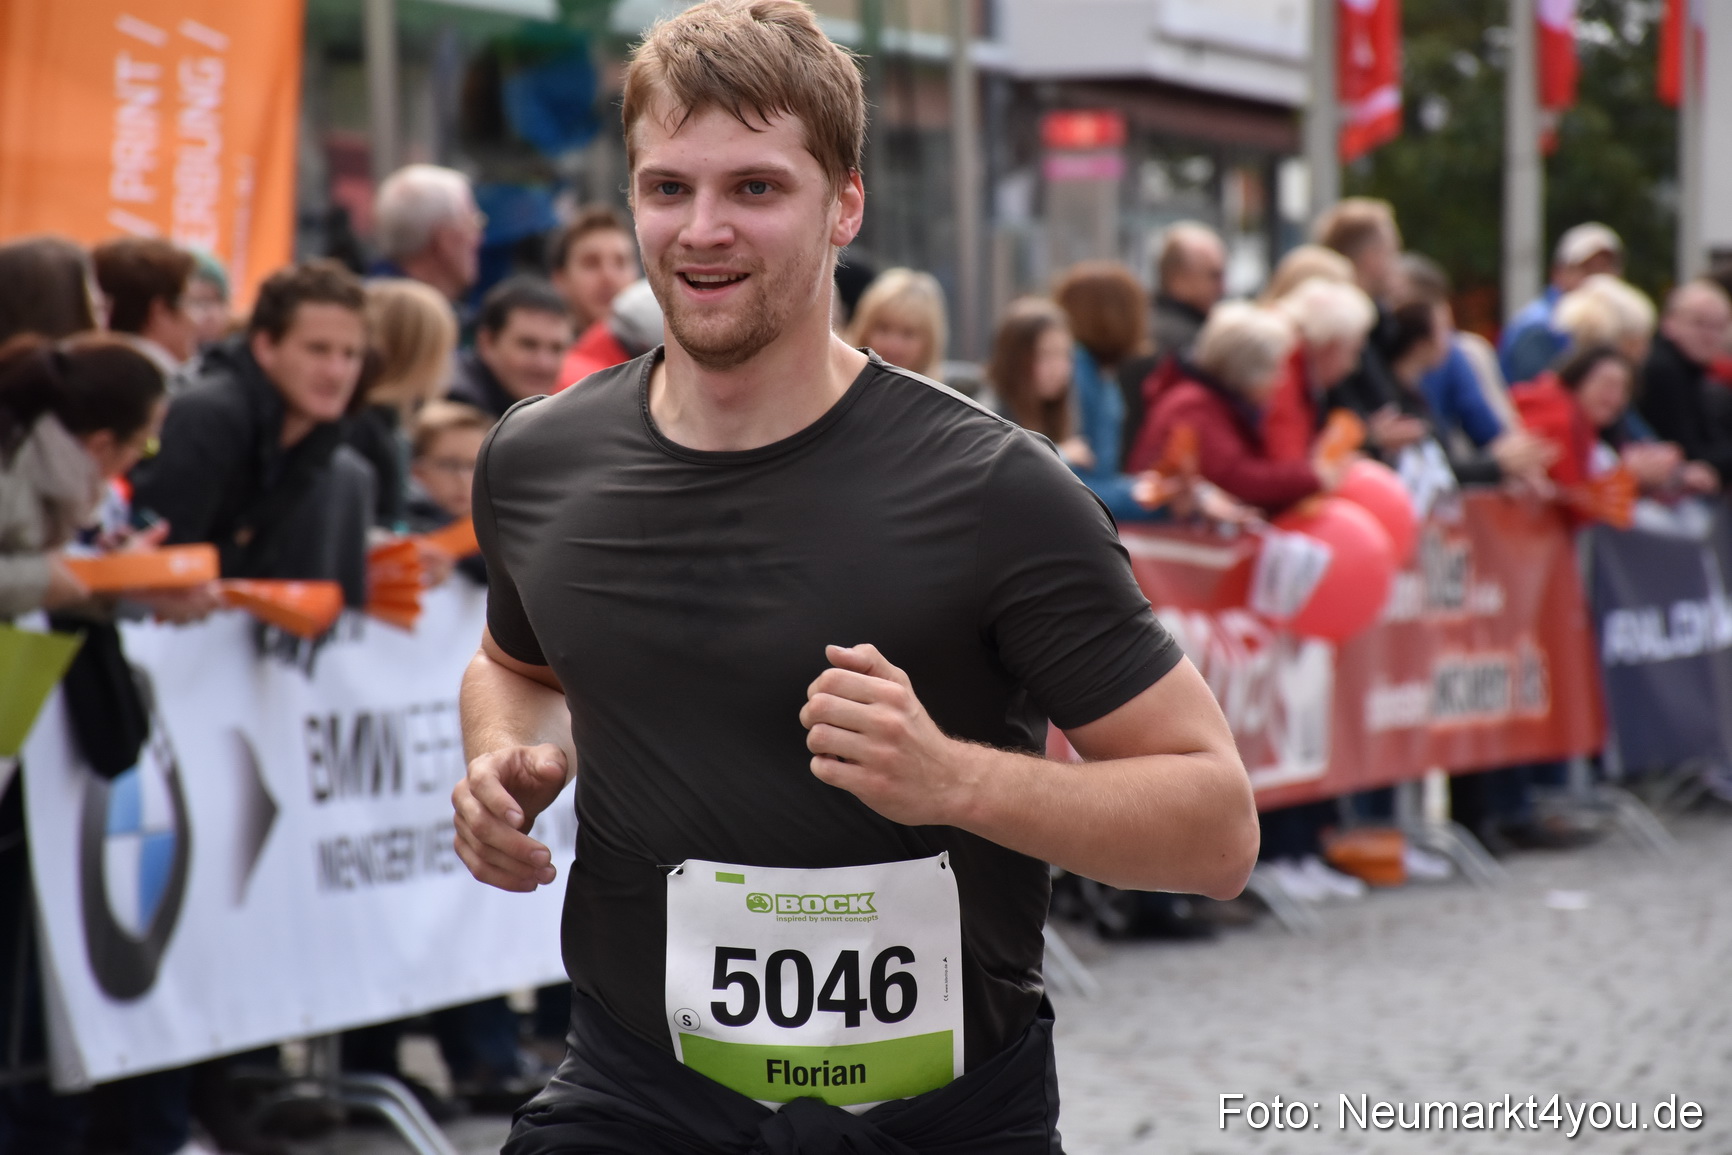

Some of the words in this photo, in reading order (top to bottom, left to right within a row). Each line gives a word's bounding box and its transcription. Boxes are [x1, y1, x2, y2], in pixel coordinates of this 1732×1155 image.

[110, 50, 163, 203] PRINT
[171, 56, 225, 251] ERBUNG
[304, 710, 404, 803] BMW
[775, 892, 877, 914] BOCK
[776, 915, 807, 923] inspired
[809, 915, 818, 923] by
[844, 914, 879, 923] concepts
[710, 945, 918, 1029] 5046
[681, 1013, 693, 1027] S
[766, 1058, 867, 1088] Florian
